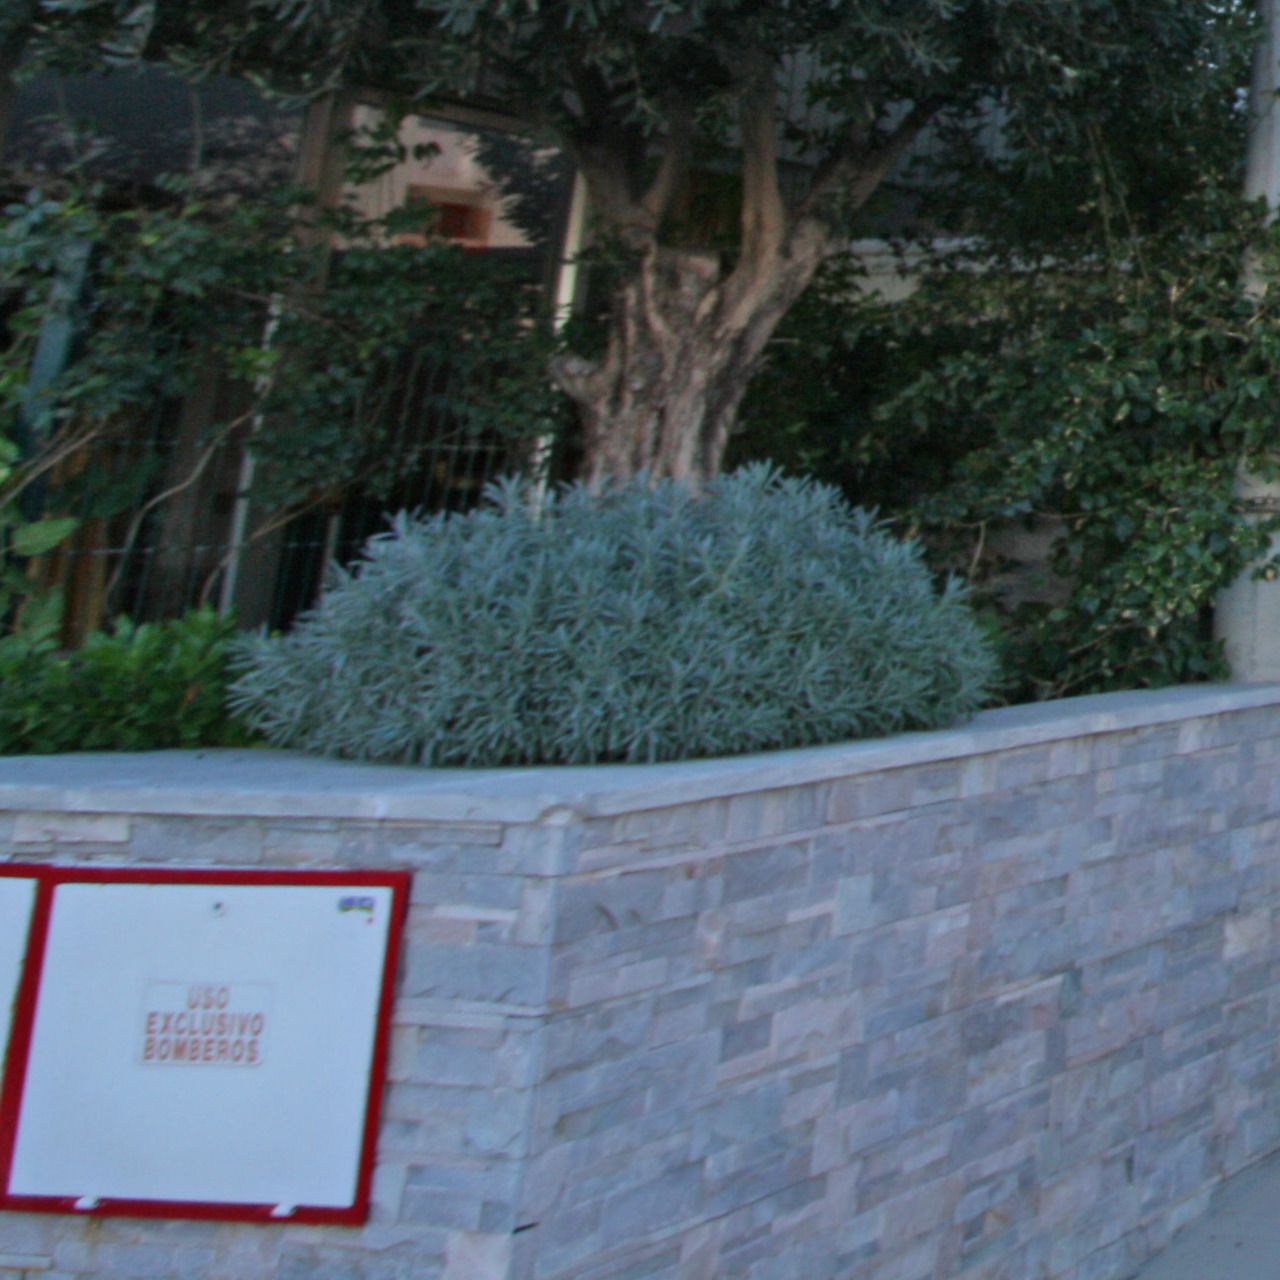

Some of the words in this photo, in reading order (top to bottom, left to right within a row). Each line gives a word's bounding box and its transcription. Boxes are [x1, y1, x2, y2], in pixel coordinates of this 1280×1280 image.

[187, 985, 231, 1010] USO
[145, 1010, 265, 1037] EXCLUSIVO
[143, 1037, 260, 1063] BOMBEROS
